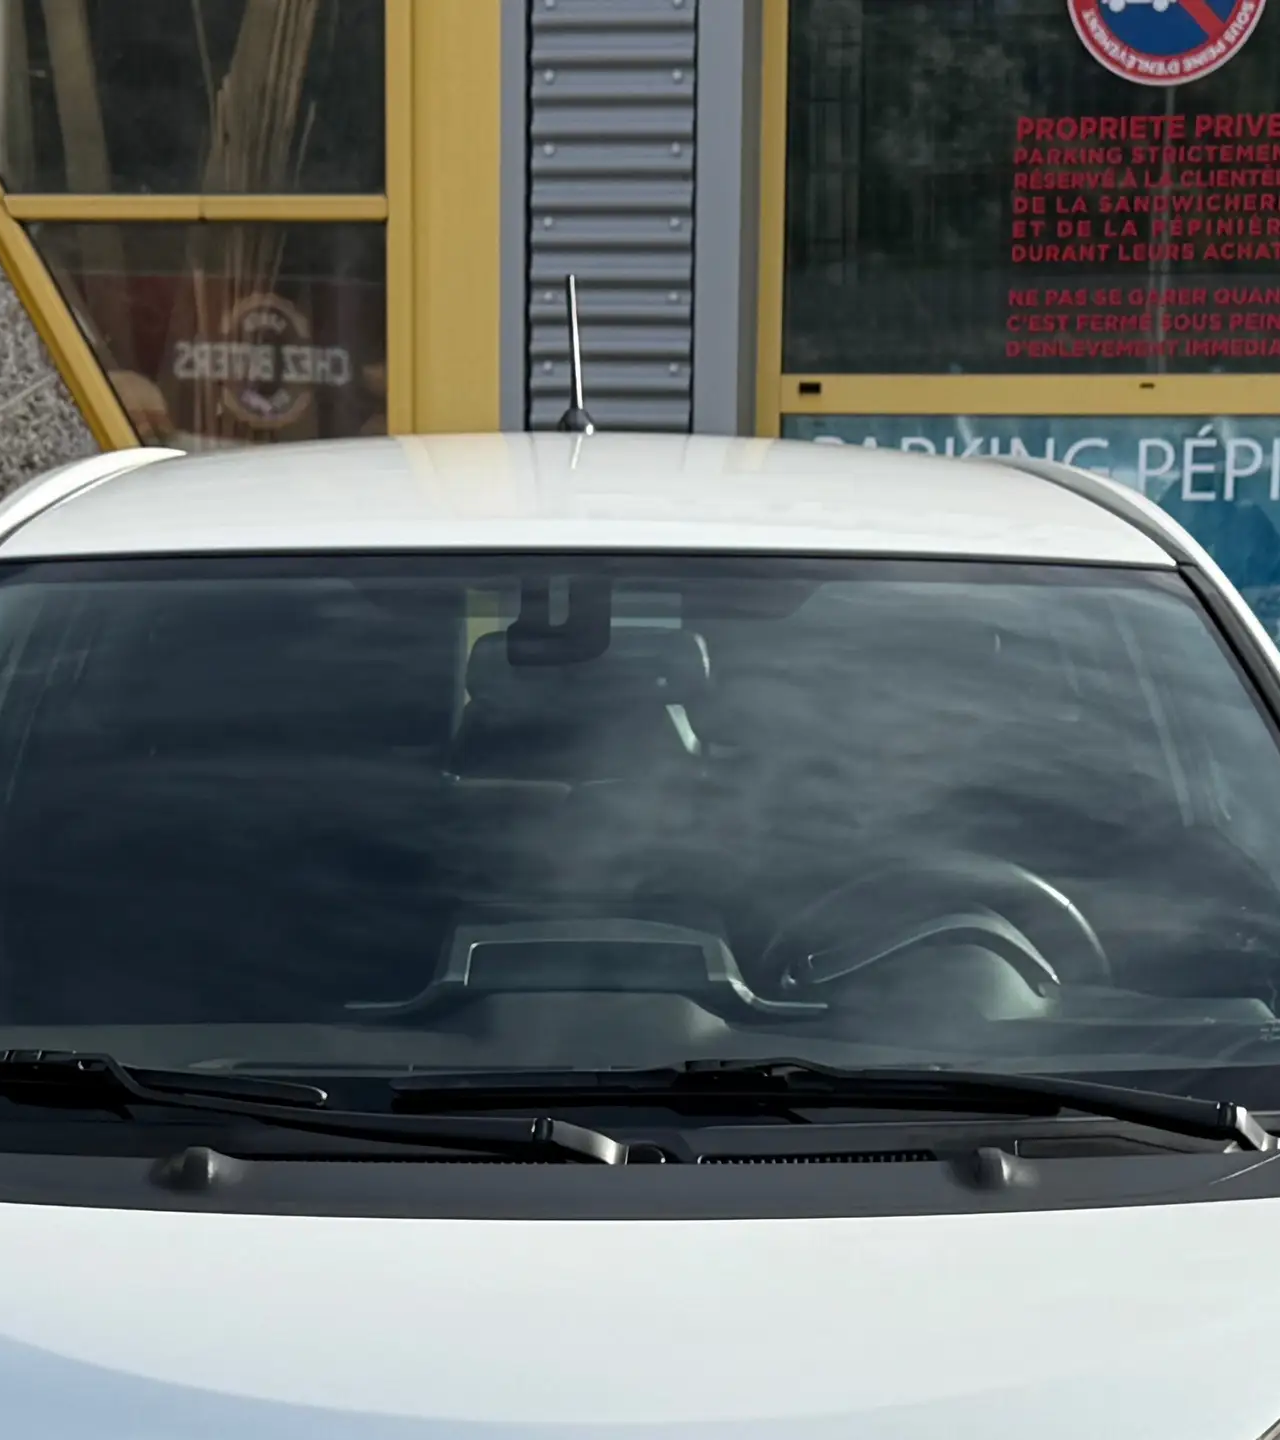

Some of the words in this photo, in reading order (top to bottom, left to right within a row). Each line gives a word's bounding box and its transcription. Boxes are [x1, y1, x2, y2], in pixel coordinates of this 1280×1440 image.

[1016, 116, 1185, 141] PROPRIETE
[1013, 146, 1123, 164] PARKING
[1013, 168, 1116, 189] RÉSERVÉ
[1120, 167, 1137, 189] À
[1144, 171, 1174, 188] LA
[1013, 196, 1046, 215] DE
[1056, 196, 1087, 214] LA
[1012, 220, 1046, 238] ET
[1057, 220, 1091, 238] DE
[1104, 219, 1138, 237] LA
[1012, 244, 1110, 262] DURANT
[1118, 243, 1194, 261] LEURS
[1008, 289, 1039, 306] NE
[1045, 289, 1086, 306] PAS
[1094, 289, 1122, 306] SE
[1128, 288, 1206, 305] GARER
[1006, 314, 1069, 332] C'EST
[1076, 312, 1152, 332] FERMÉ
[1161, 313, 1221, 331] SOUS
[1005, 339, 1179, 358] D'ENLEVEMENT
